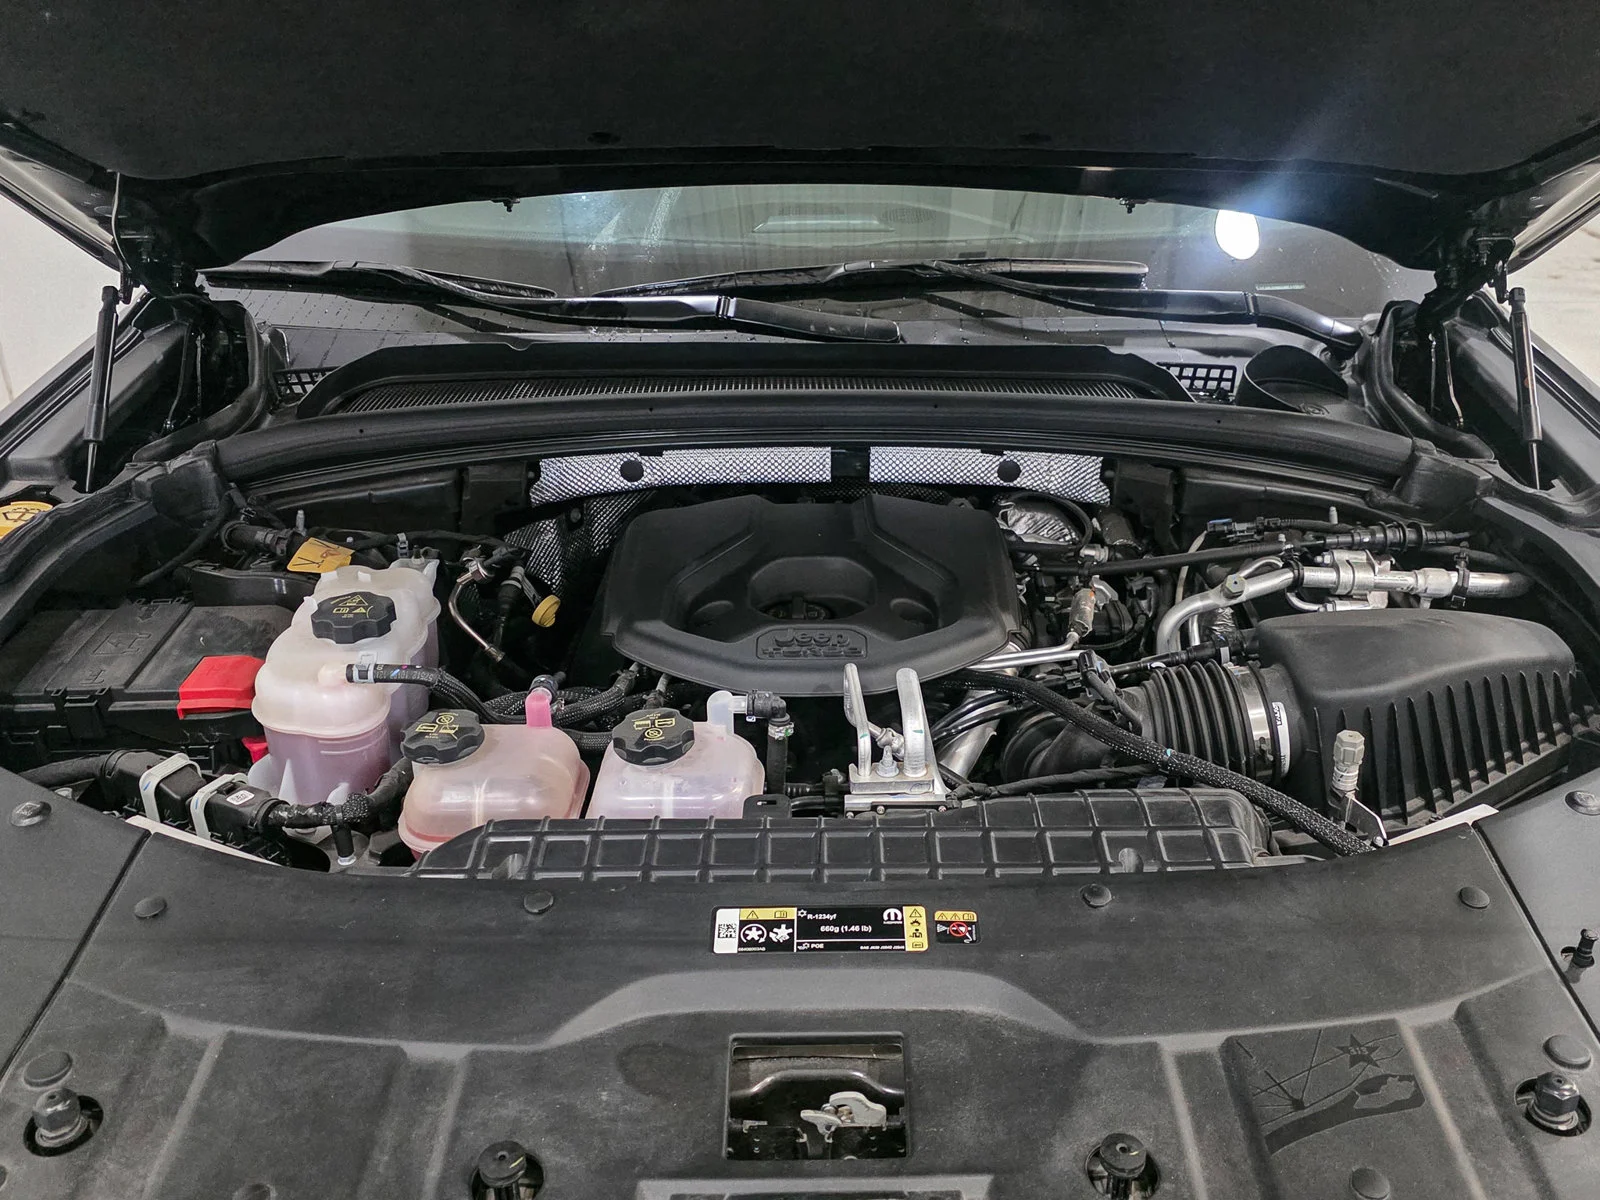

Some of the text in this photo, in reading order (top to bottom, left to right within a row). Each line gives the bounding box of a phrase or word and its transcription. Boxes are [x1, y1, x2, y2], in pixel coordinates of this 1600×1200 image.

[773, 628, 851, 648] Jeep
[807, 913, 837, 921] R-1234yf
[841, 925, 860, 933] (1.46
[861, 925, 872, 933] lb)
